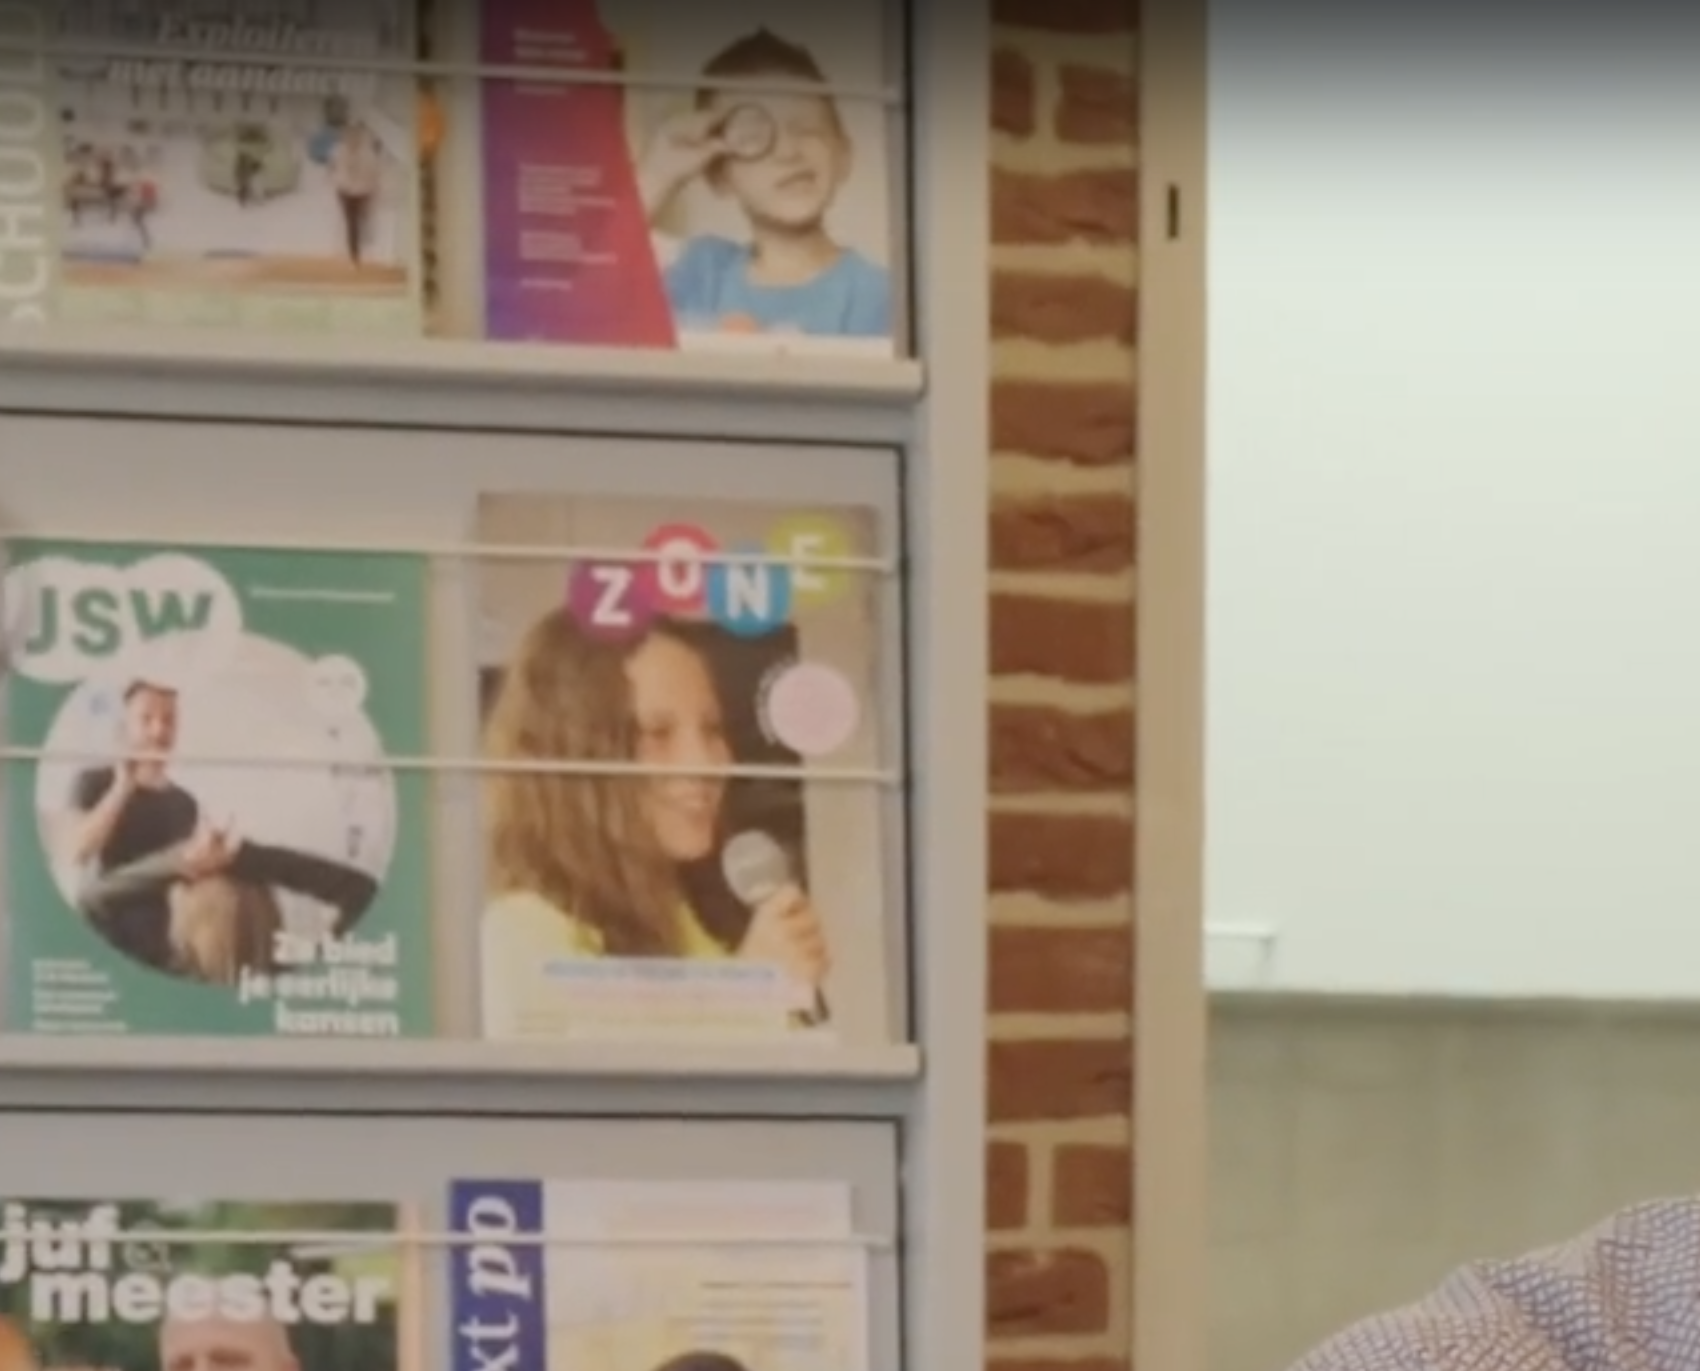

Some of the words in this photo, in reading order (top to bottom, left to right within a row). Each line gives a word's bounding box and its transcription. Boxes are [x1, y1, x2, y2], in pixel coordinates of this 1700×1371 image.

[590, 533, 827, 626] ZONE
[25, 584, 213, 656] JSW
[29, 1260, 391, 1325] meester
